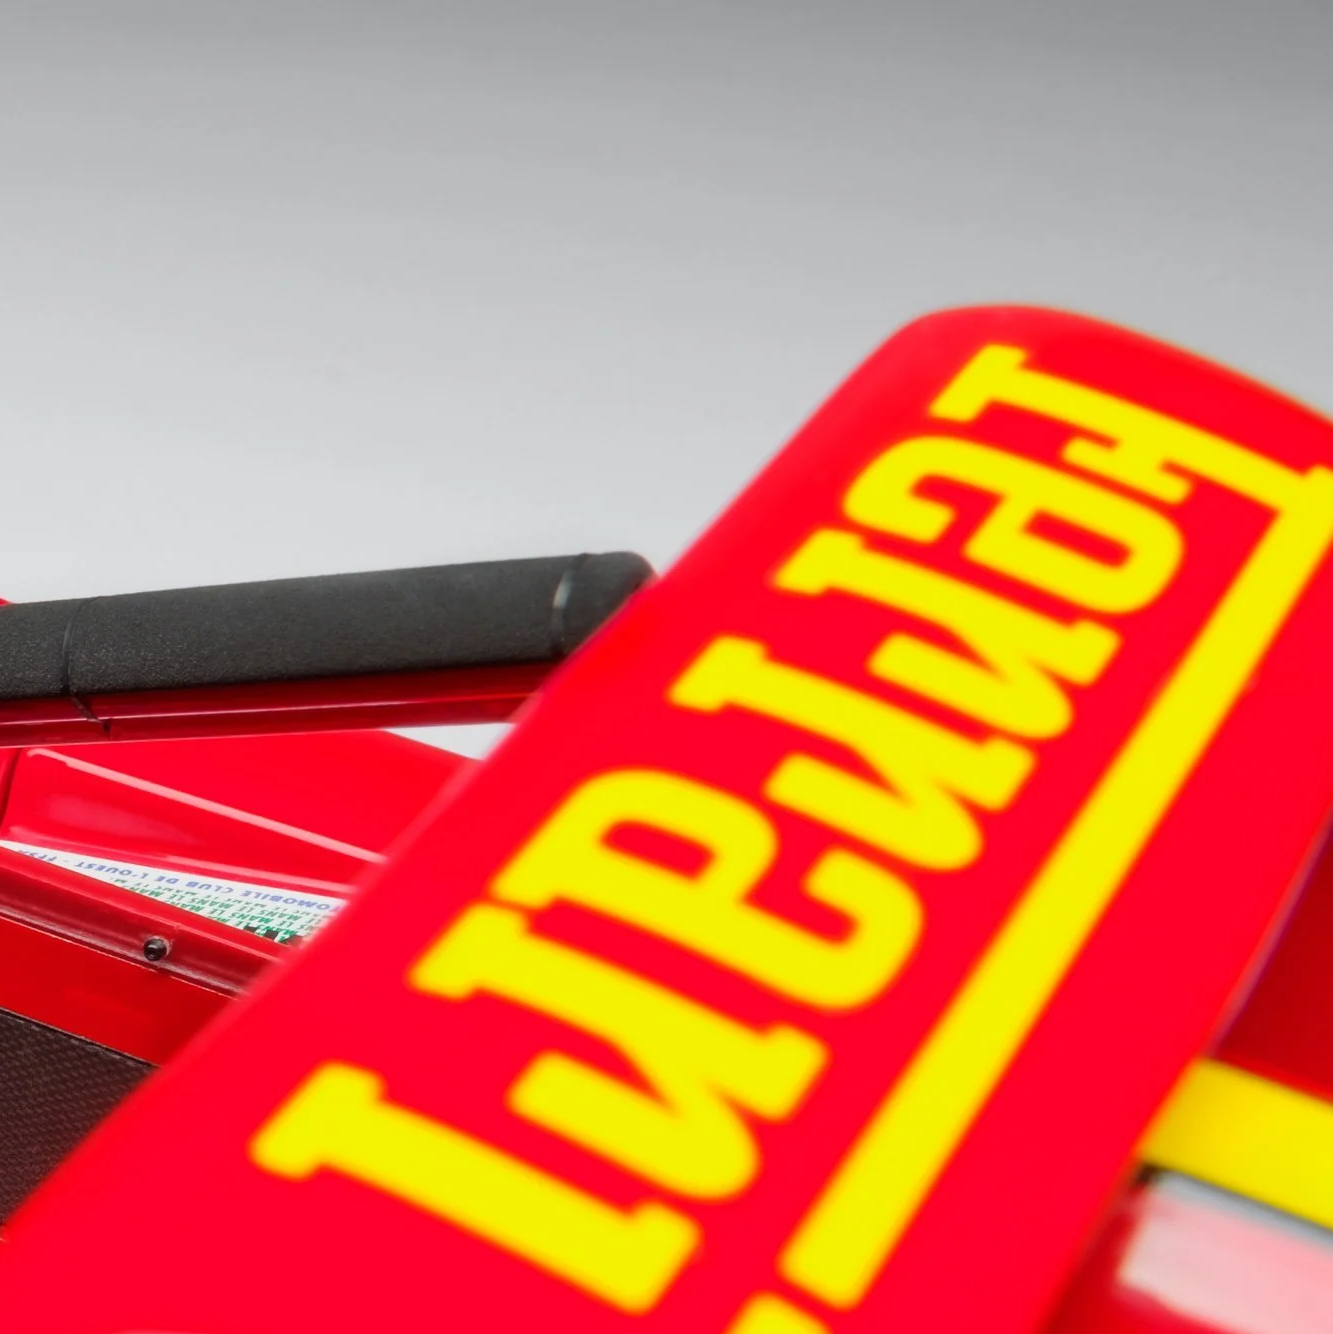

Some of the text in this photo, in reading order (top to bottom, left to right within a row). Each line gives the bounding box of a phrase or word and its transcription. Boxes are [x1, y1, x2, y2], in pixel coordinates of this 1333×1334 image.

[154, 875, 180, 885] DE
[184, 880, 235, 894] CLUB
[188, 896, 235, 910] MANS
[230, 912, 275, 925] MANS
[259, 908, 303, 922] MANS
